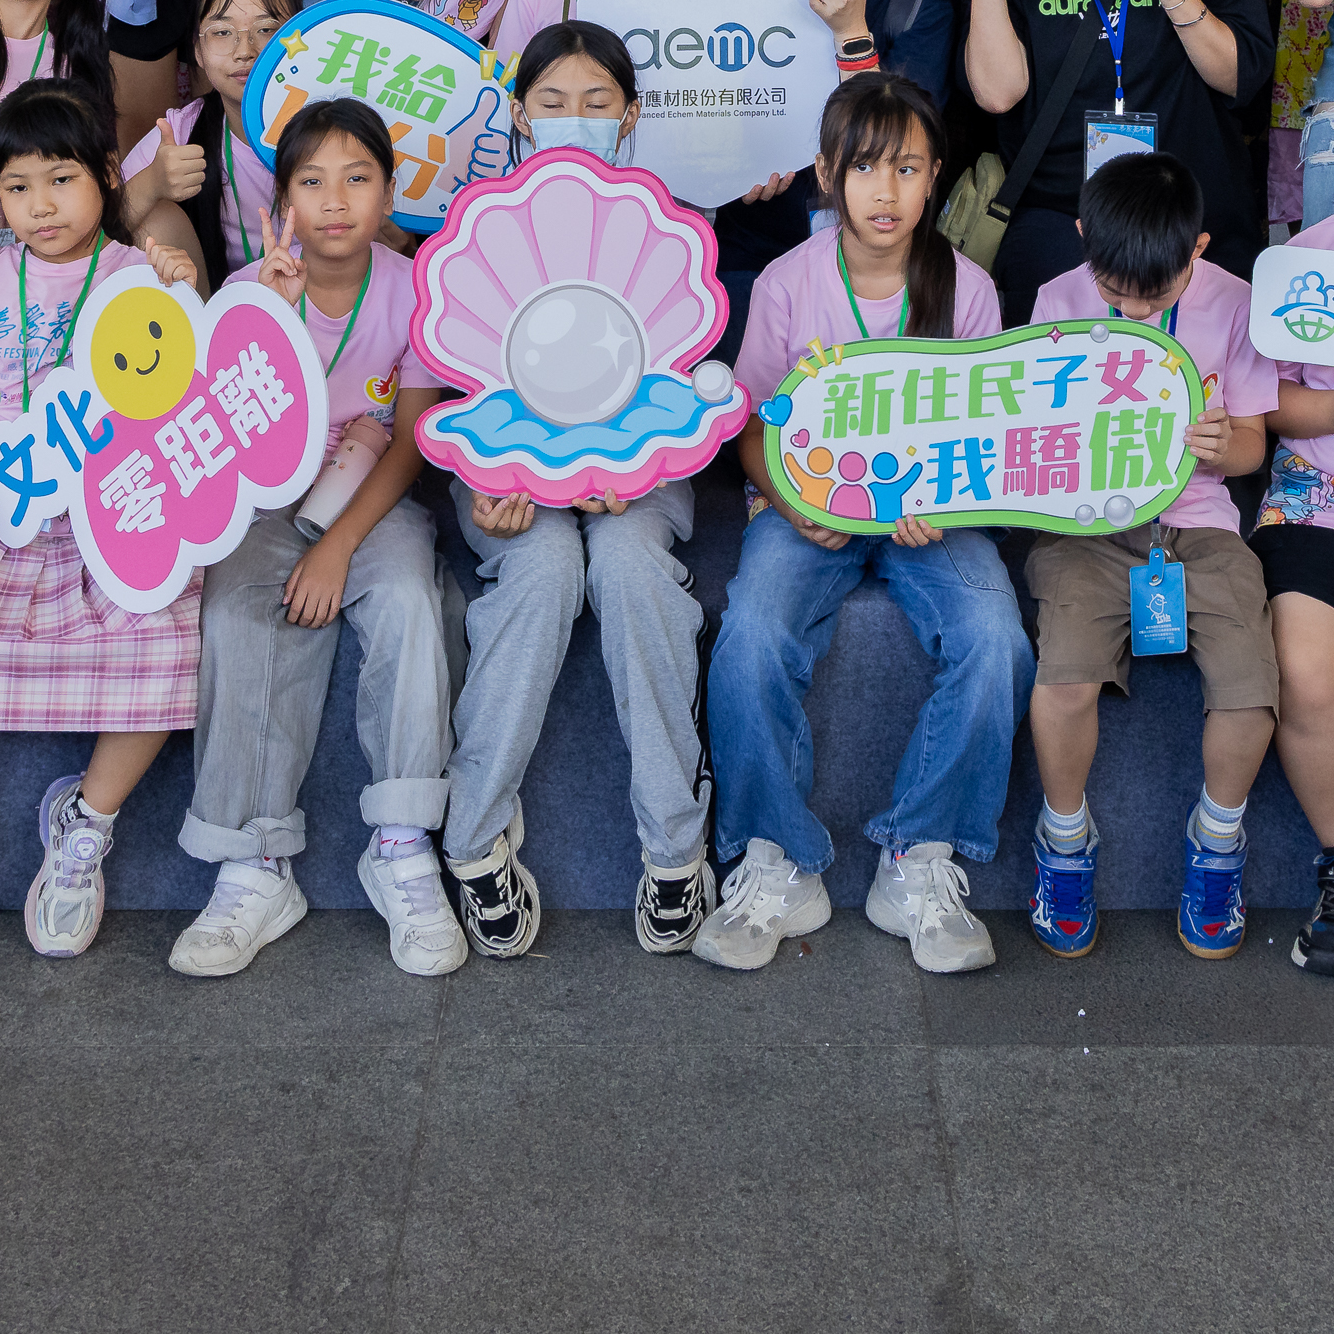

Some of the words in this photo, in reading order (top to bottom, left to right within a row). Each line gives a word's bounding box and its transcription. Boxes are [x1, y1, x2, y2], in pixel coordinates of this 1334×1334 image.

[316, 29, 457, 124] 我給
[622, 22, 797, 72] aemc
[638, 111, 665, 119] vanced
[667, 110, 693, 118] Echem
[696, 110, 731, 118] Materials
[733, 109, 770, 118] Company
[772, 108, 786, 116] Ltd.
[98, 341, 295, 534] 零距離
[821, 349, 1153, 439] 新住民子女
[926, 406, 1177, 506] 我驕傲
